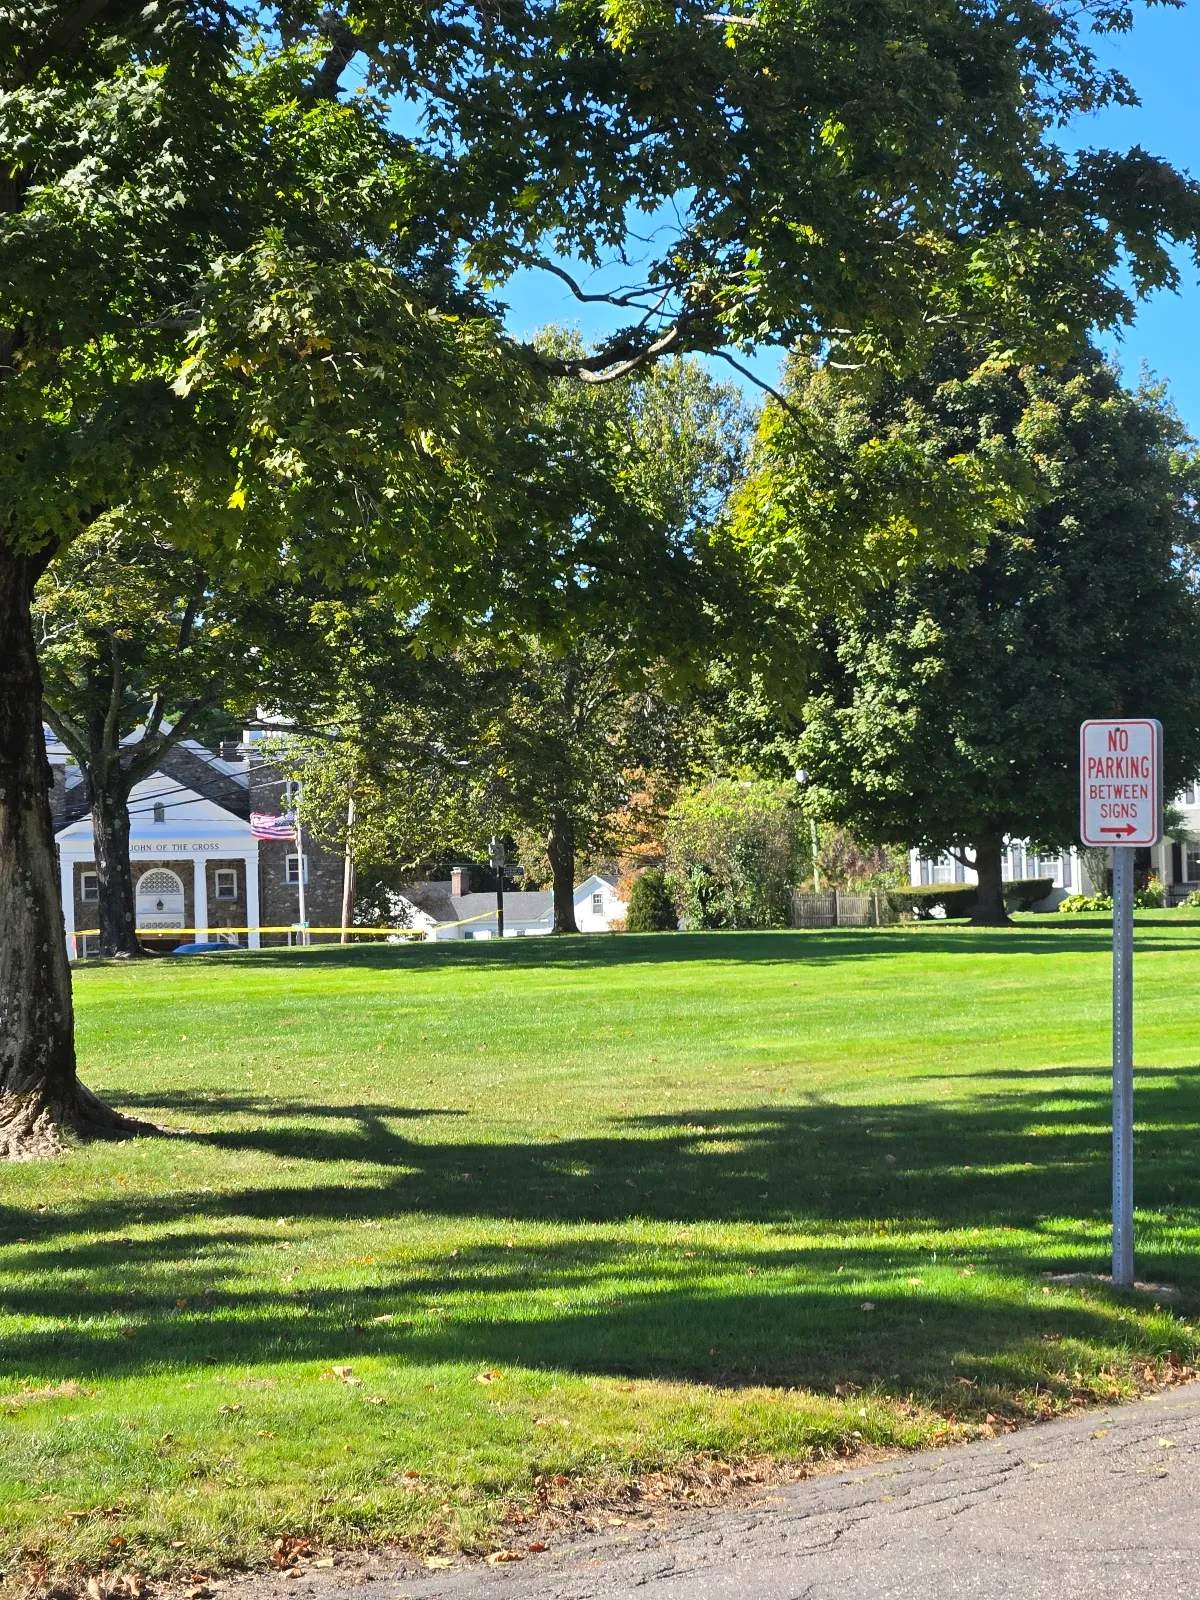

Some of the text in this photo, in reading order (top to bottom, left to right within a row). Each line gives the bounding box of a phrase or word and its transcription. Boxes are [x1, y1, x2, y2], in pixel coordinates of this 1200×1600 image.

[1108, 729, 1129, 752] NO
[1088, 756, 1150, 779] PARKING
[1089, 784, 1148, 800] BETWEEN
[1100, 803, 1138, 818] SIGNS
[129, 844, 152, 852] JOHN
[171, 843, 188, 851] THE
